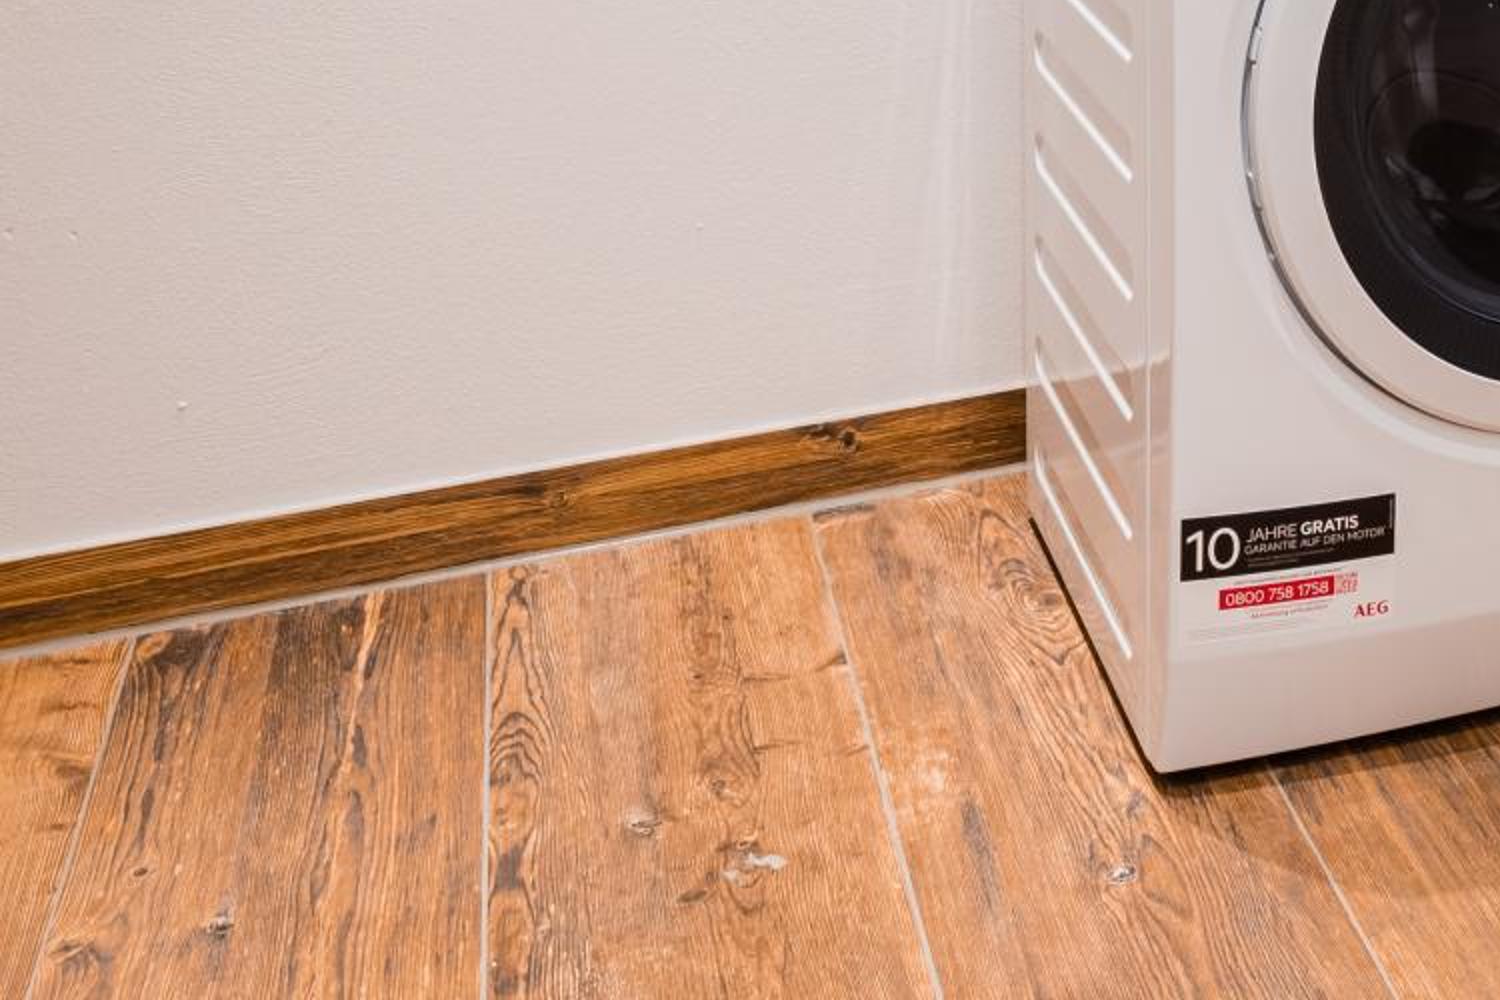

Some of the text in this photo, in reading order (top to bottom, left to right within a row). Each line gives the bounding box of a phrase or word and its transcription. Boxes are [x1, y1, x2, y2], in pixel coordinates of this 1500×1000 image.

[1245, 515, 1359, 543] JAHRE GRATIS
[1185, 527, 1242, 573] 10
[1243, 540, 1298, 555] GARANTIE
[1300, 536, 1322, 548] AUF
[1324, 533, 1345, 545] DEN
[1225, 589, 1265, 606] 0800
[1268, 585, 1294, 602] 758
[1297, 580, 1330, 598] 1758
[1353, 599, 1390, 618] AEG
